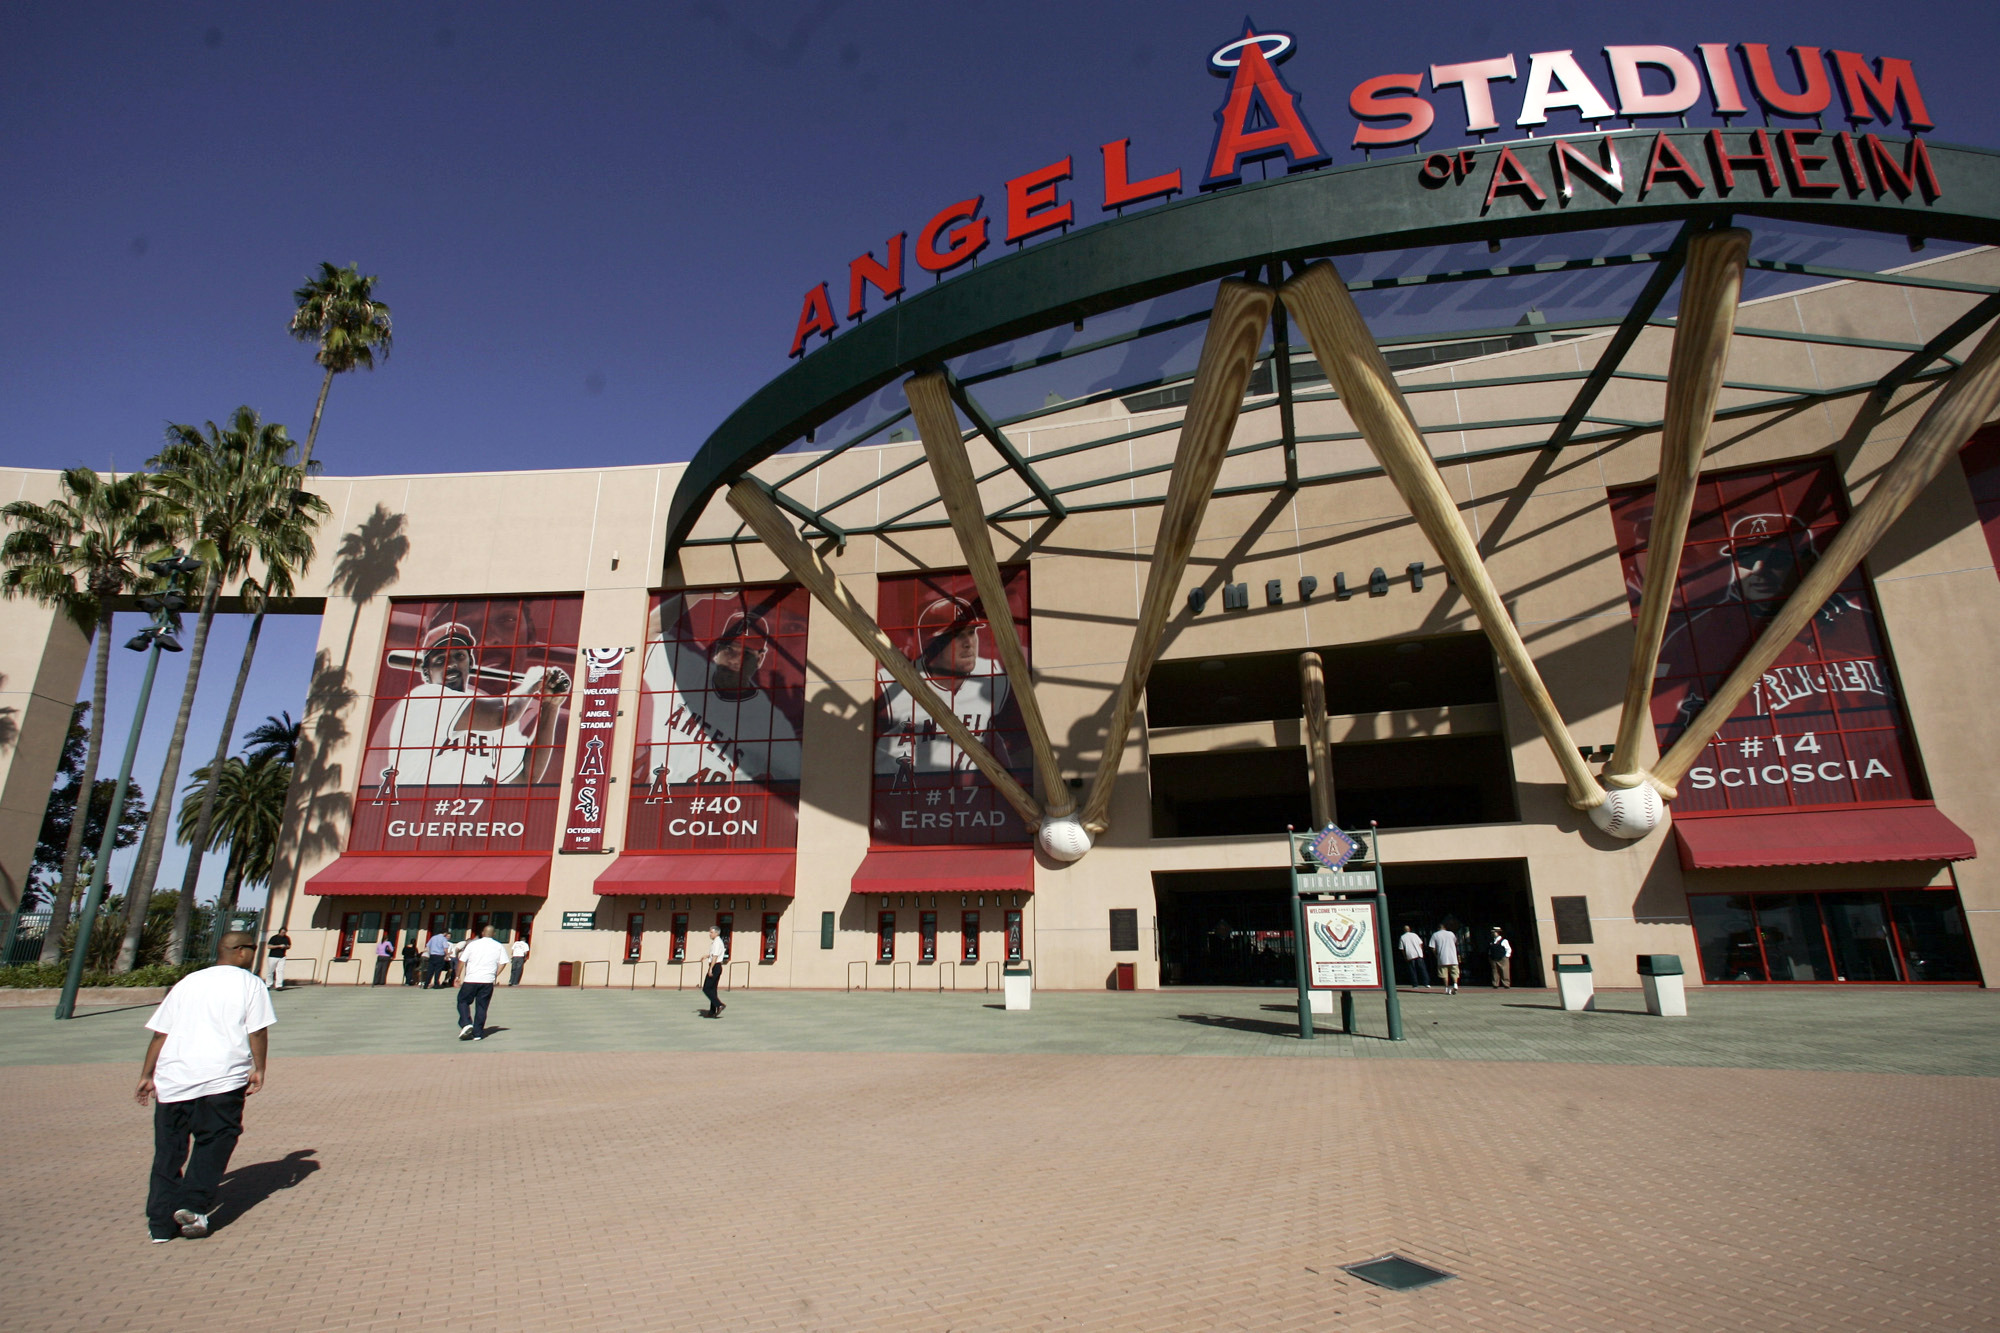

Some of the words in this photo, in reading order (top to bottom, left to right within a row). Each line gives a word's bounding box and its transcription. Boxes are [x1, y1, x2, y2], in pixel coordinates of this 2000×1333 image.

[1418, 151, 1476, 189] OF
[1480, 128, 1942, 217] ANAHEIM
[789, 137, 1183, 359] ANGEL
[1200, 15, 1333, 193] A
[1348, 42, 1935, 150] STADIUM
[1740, 732, 1821, 759] #14
[1689, 758, 1893, 790] SCIOSCIA
[689, 796, 741, 814] #40
[925, 786, 979, 806] #17
[434, 798, 485, 816] #27
[387, 820, 525, 837] GUERRERO
[668, 818, 758, 837] COLON
[901, 810, 1006, 829] ERSTAD
[1302, 875, 1371, 888] DIRECTORY
[640, 898, 691, 910] WILL
[713, 898, 767, 910] CALL
[882, 896, 937, 908] WILL
[961, 896, 1018, 908] CALL
